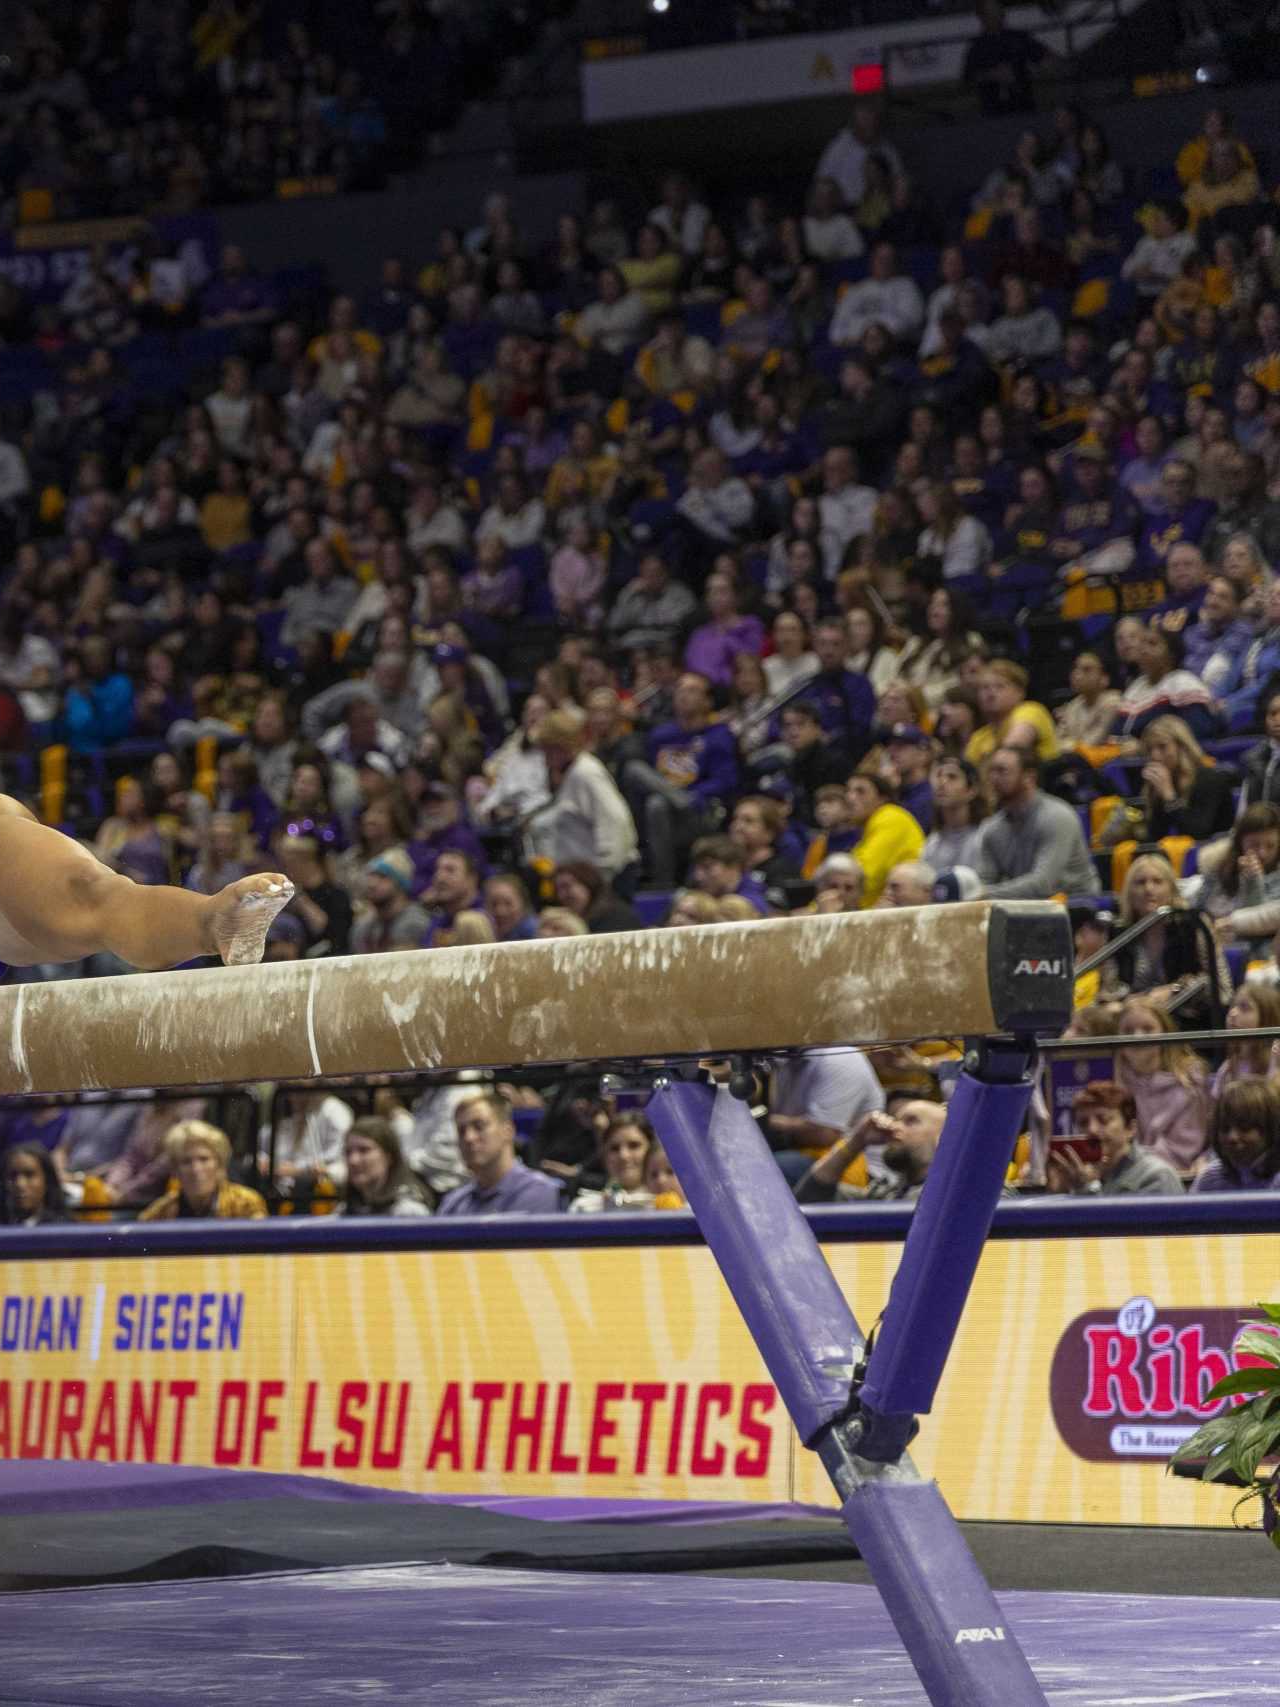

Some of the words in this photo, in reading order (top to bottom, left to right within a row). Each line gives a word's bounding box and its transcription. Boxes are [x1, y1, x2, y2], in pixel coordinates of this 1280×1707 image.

[114, 1293, 243, 1352] SIEGEN
[213, 1380, 285, 1466] OF
[298, 1381, 410, 1469] LSU
[423, 1381, 777, 1478] ATHLETICS
